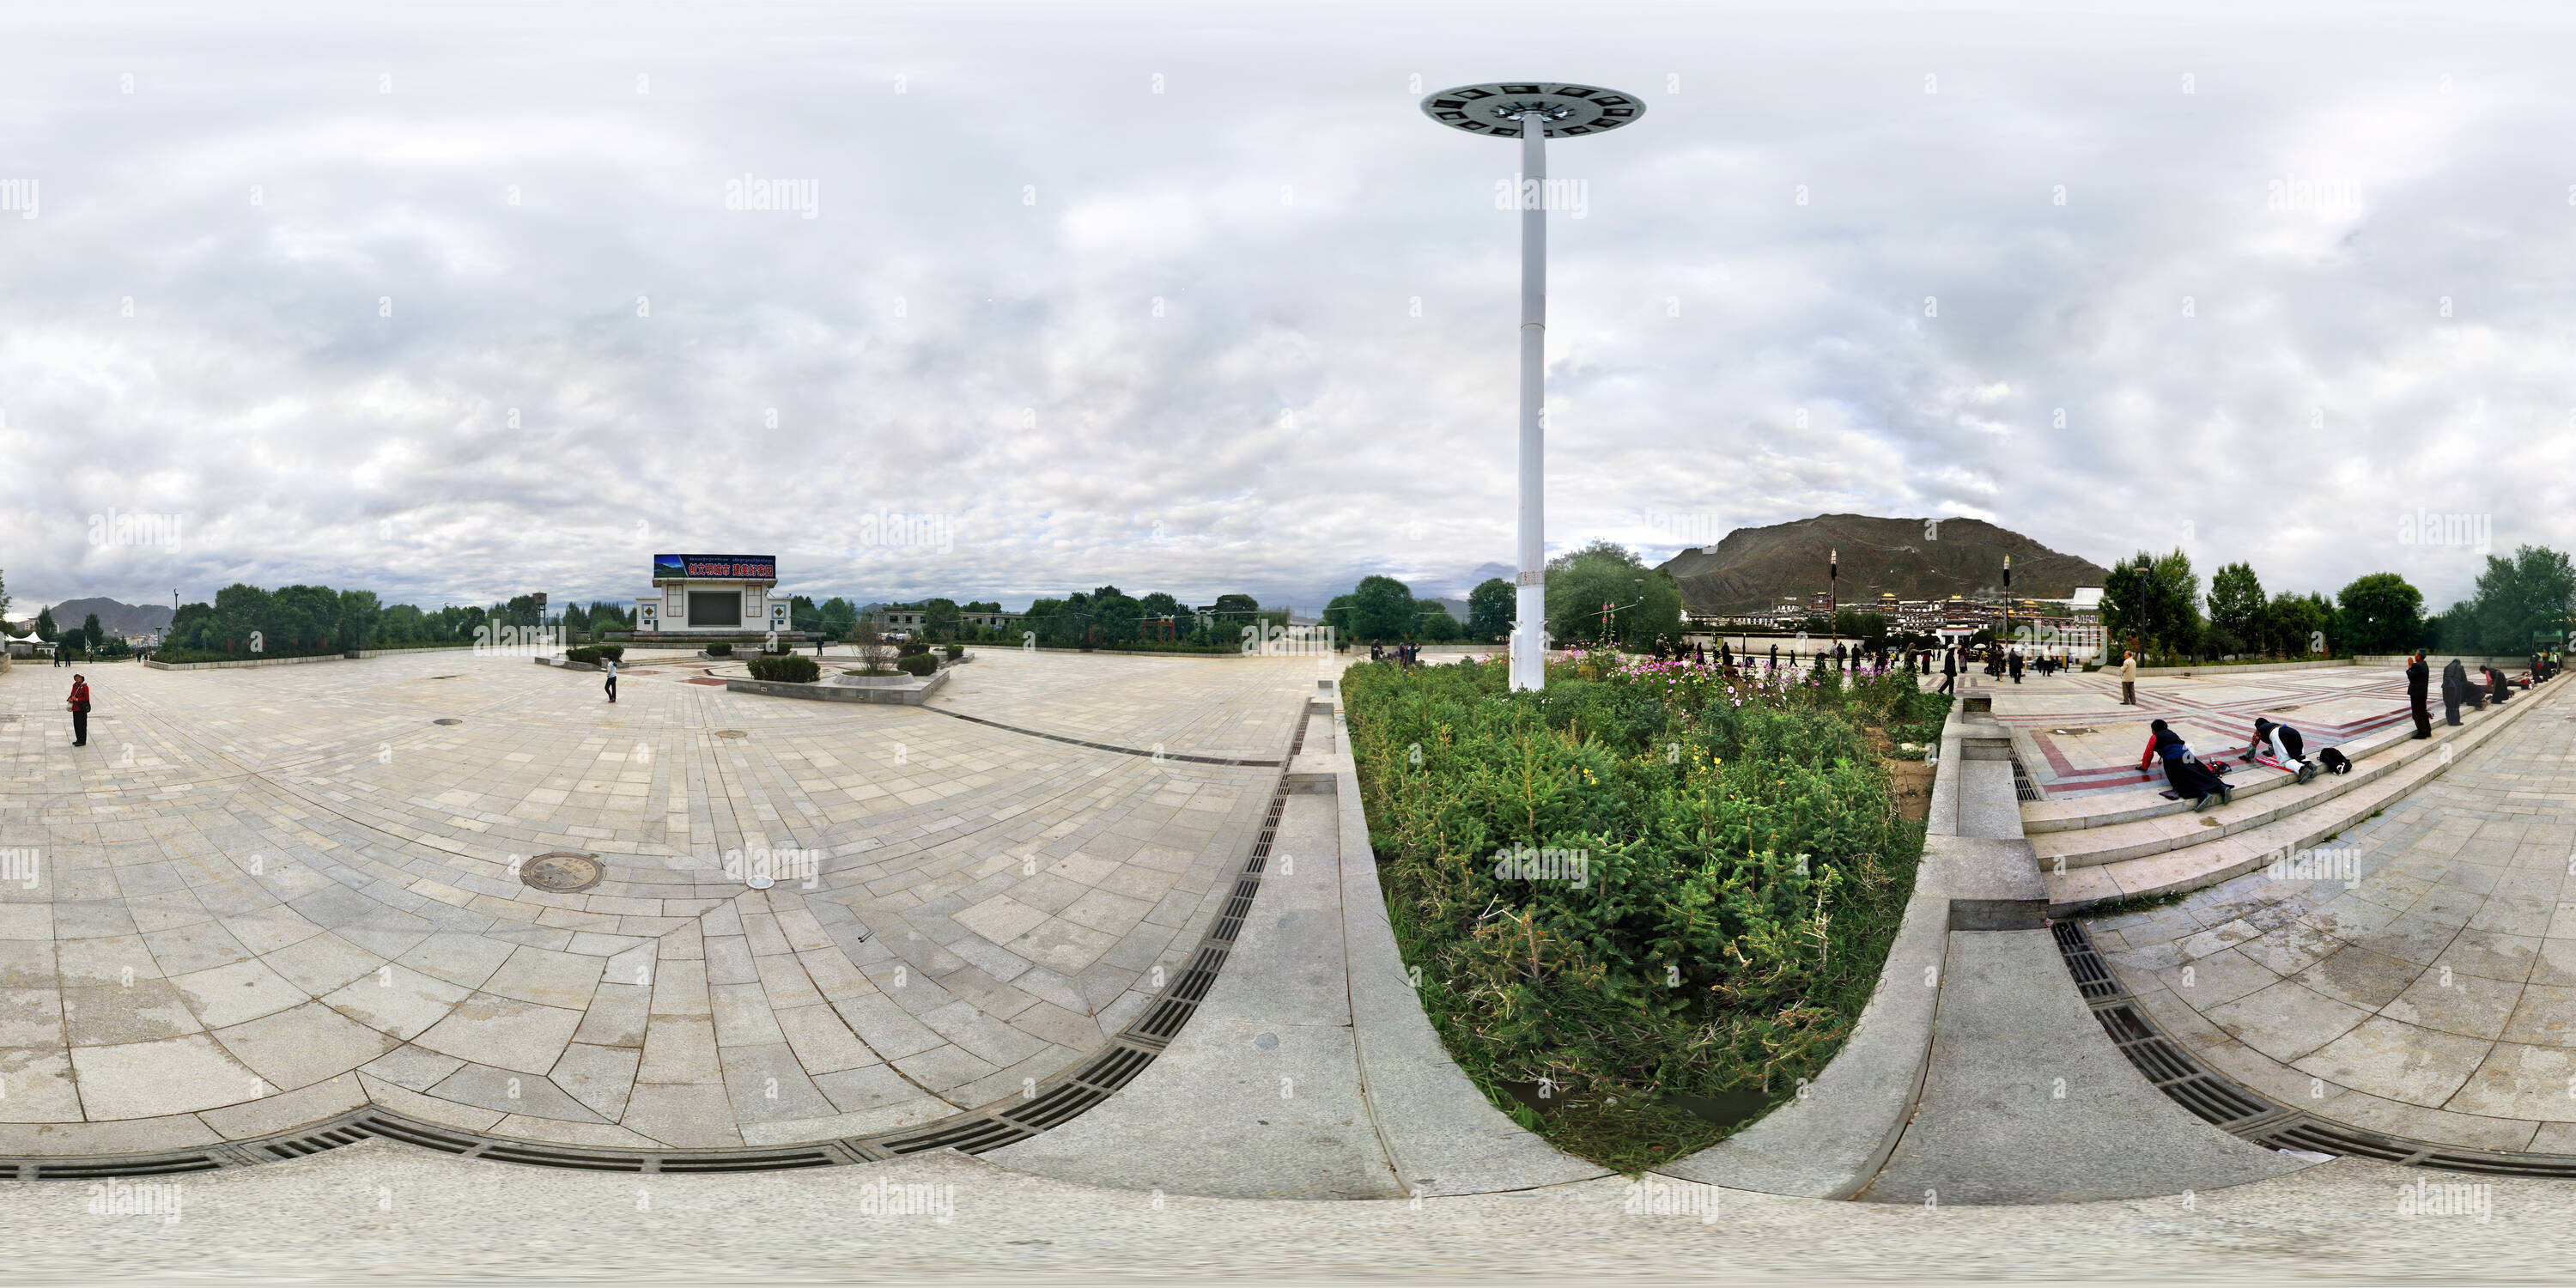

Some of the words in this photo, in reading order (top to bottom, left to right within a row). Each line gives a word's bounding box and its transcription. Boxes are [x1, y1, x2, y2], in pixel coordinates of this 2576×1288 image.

[689, 563, 730, 575] 创文明城市
[732, 564, 773, 576] 建美好家园
